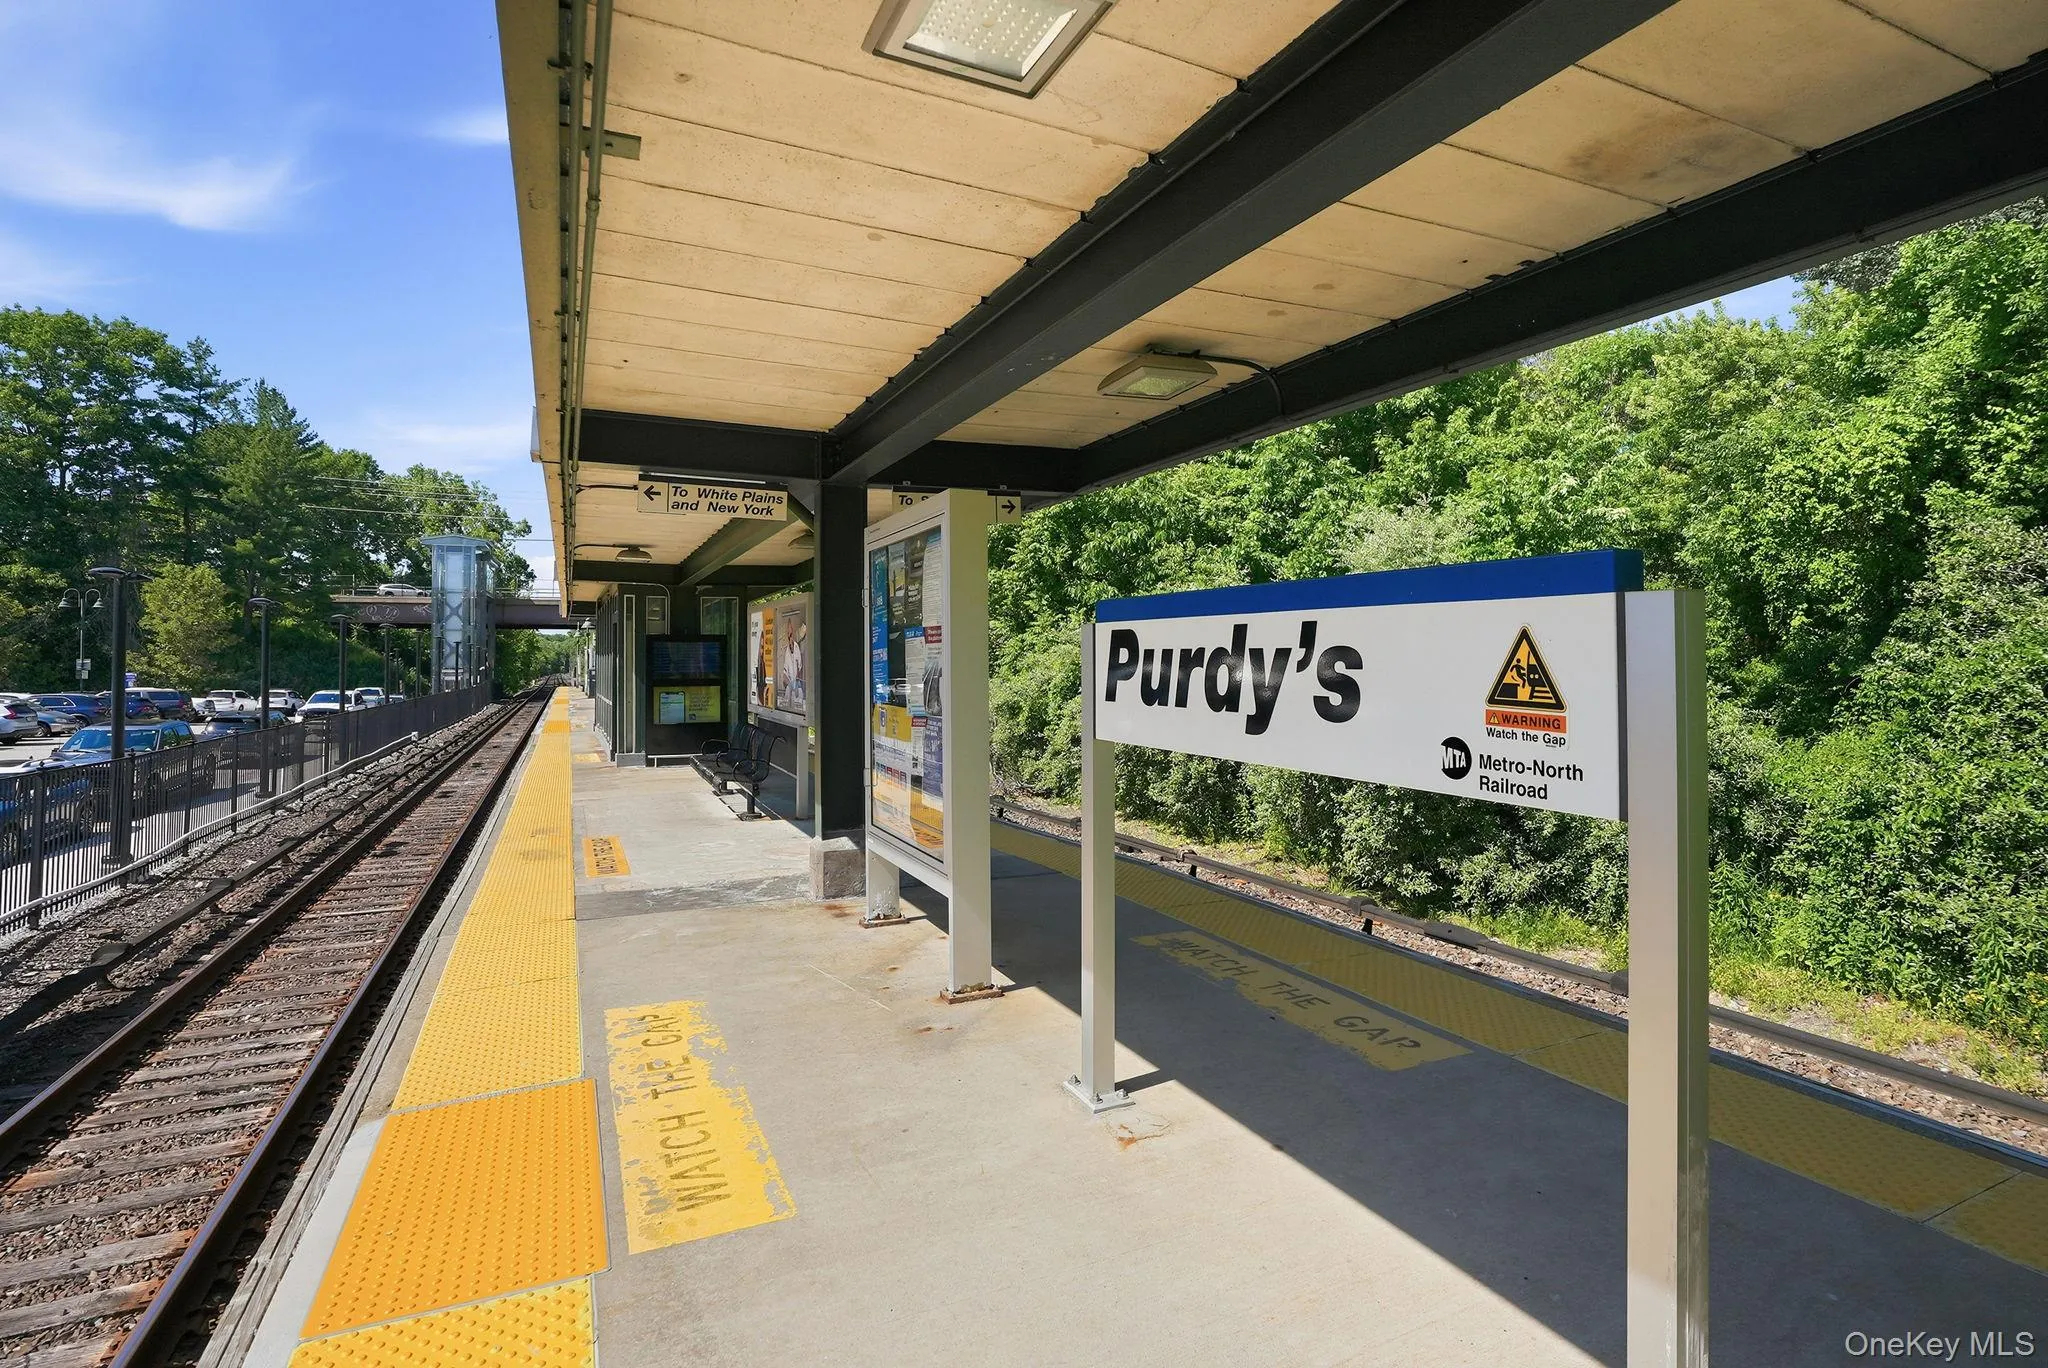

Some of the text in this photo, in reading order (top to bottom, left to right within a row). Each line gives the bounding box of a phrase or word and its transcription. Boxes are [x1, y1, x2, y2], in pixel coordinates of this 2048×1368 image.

[671, 485, 784, 505] To White Plains
[671, 500, 775, 516] and New York
[898, 494, 914, 506] To
[1104, 620, 1364, 736] Purdy's
[1501, 713, 1561, 730] WARNING
[1486, 726, 1566, 748] Watch the Gap
[1479, 753, 1584, 782] Metro-North
[1479, 774, 1548, 801] Railroad
[1161, 936, 1422, 1051] WATCH THE GAP
[645, 1055, 699, 1100] THE
[656, 1109, 732, 1213] WATCH
